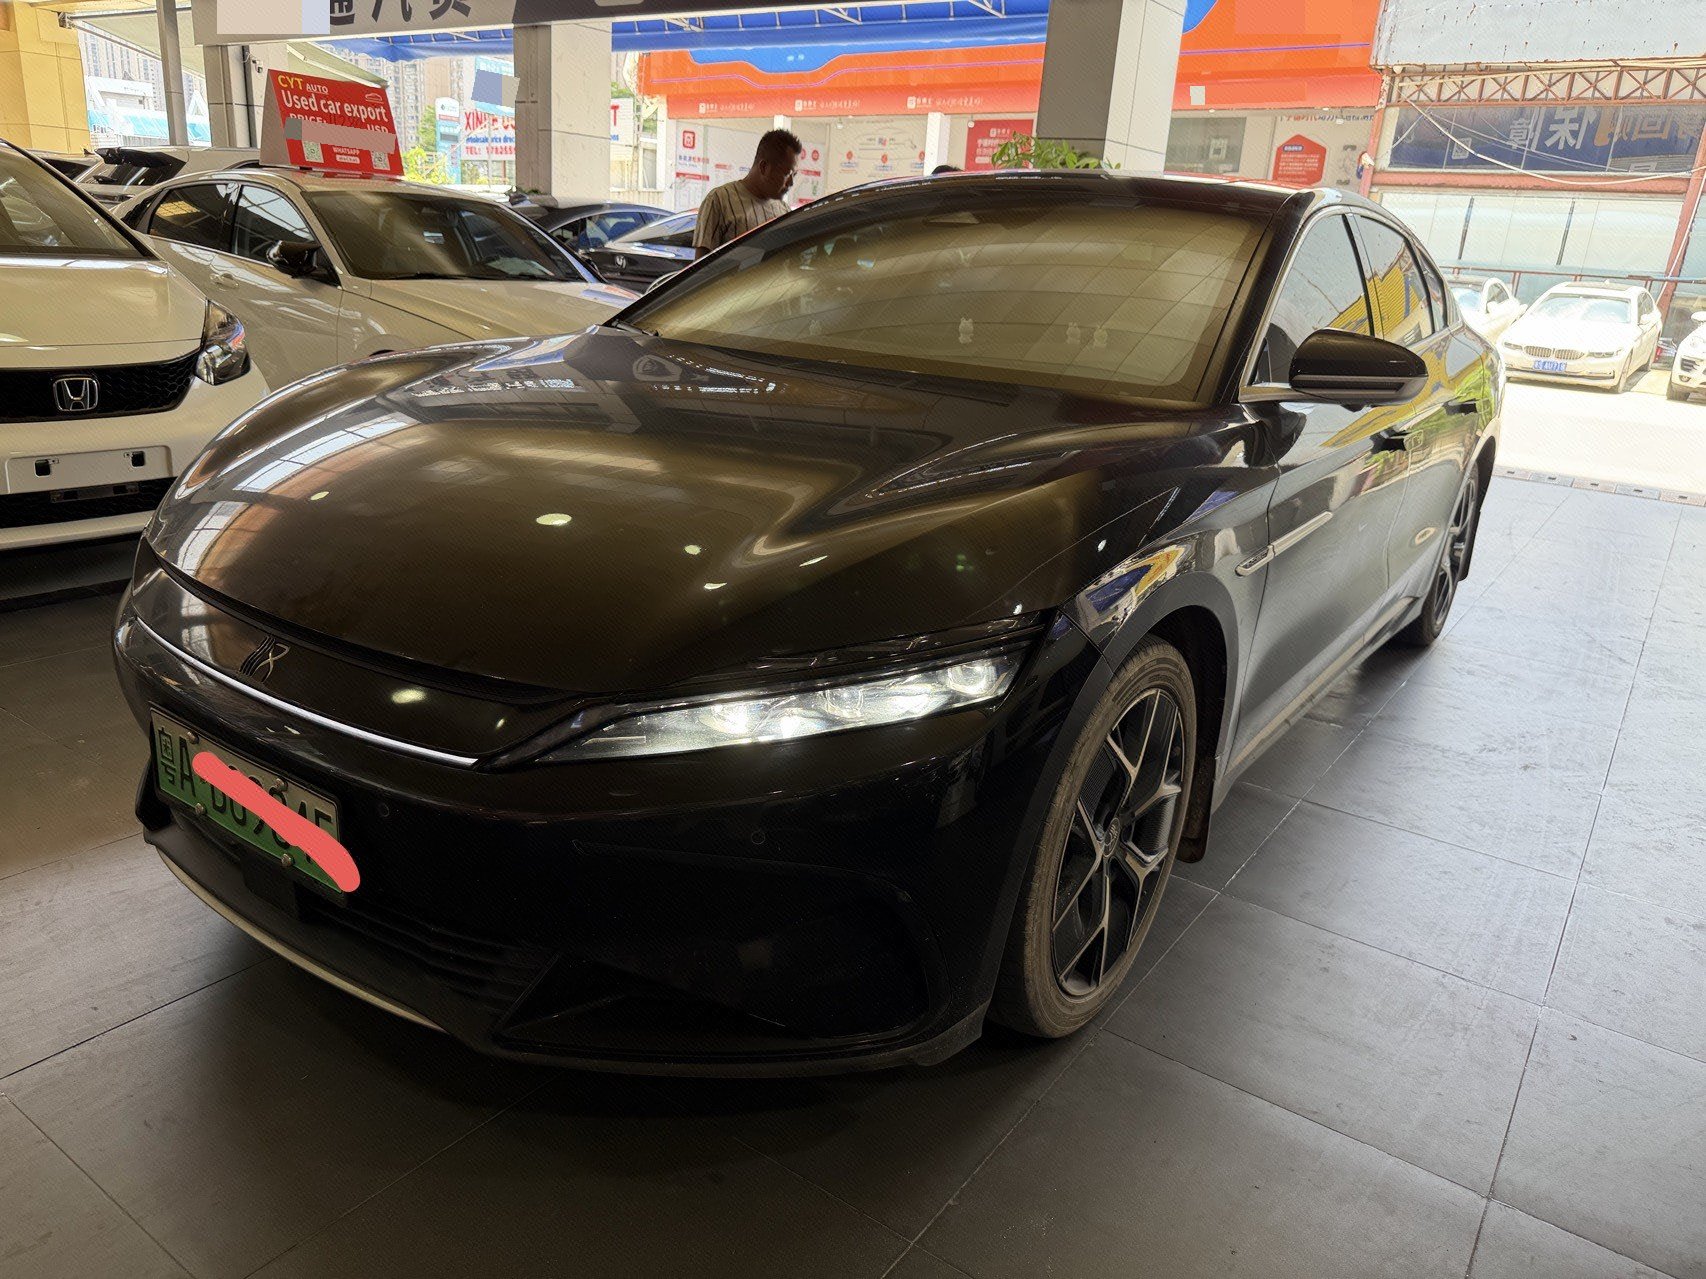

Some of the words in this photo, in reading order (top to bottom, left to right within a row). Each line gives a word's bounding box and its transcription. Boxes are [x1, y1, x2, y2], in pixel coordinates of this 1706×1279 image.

[277, 74, 303, 90] CYT
[306, 83, 329, 94] AUTO
[281, 89, 319, 111] Used
[320, 97, 342, 115] car
[343, 104, 389, 122] export
